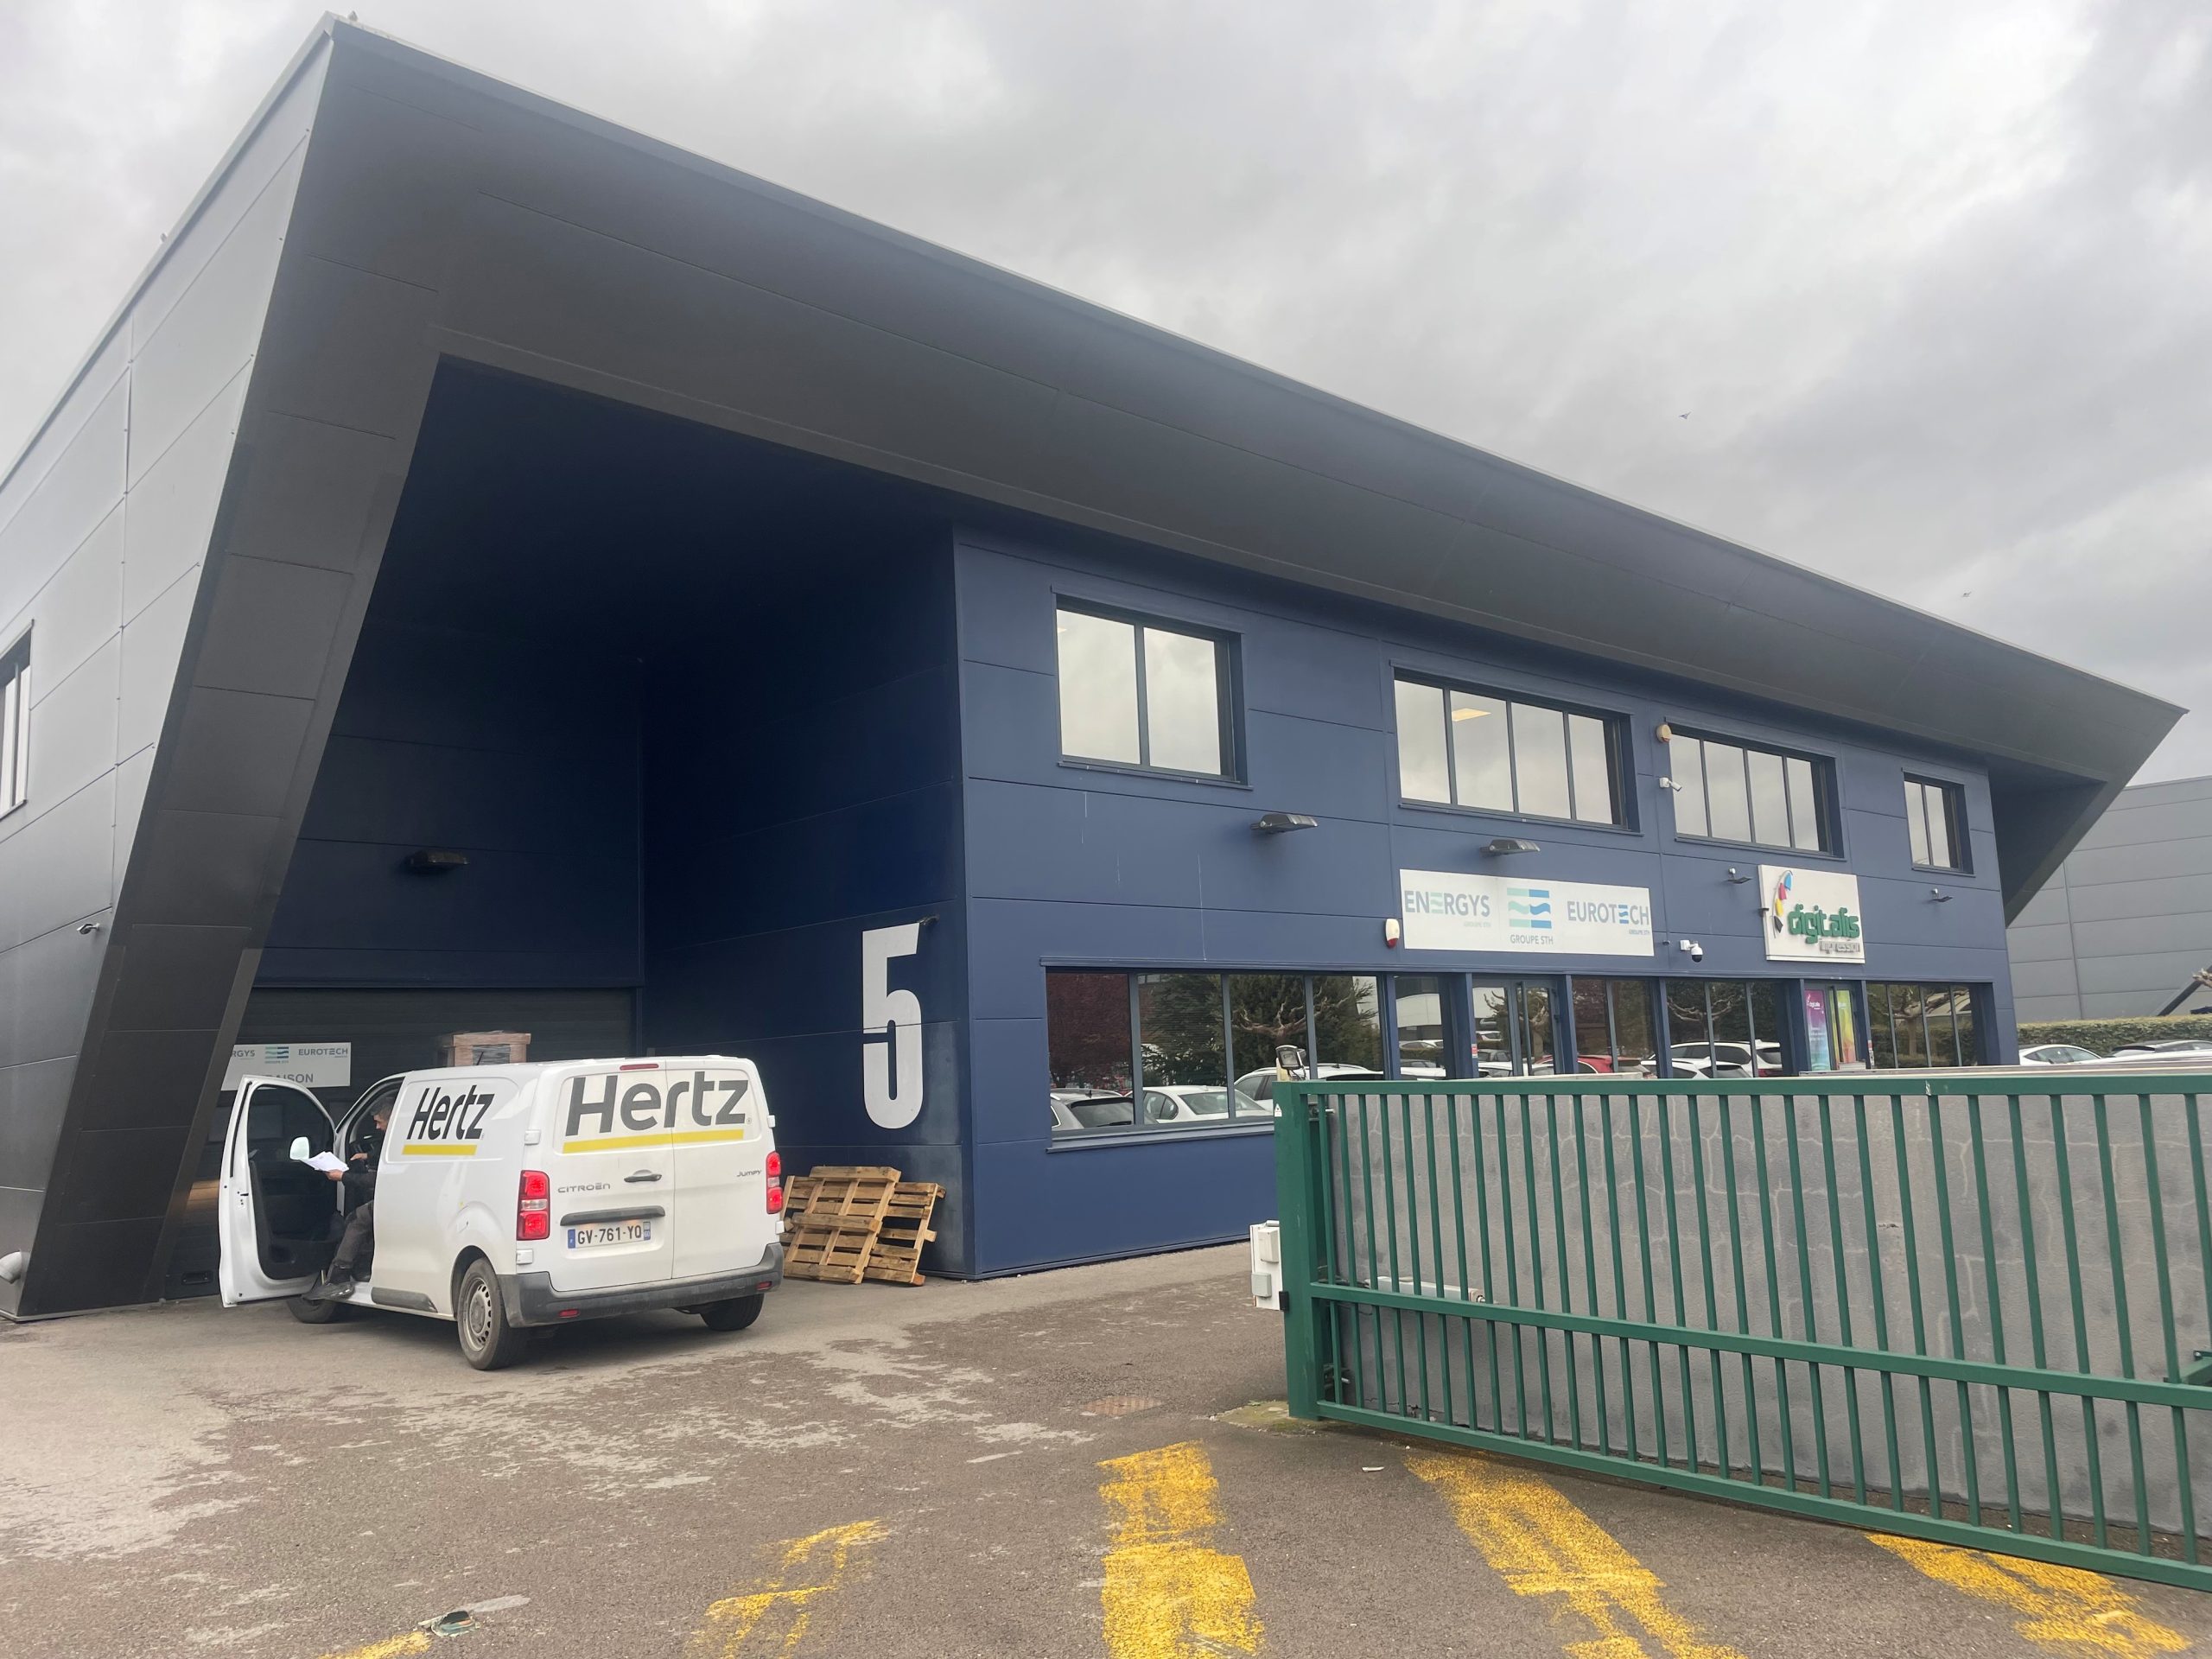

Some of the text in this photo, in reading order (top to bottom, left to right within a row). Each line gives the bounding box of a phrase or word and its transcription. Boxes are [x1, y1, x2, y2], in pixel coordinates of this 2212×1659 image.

[1404, 890, 1491, 918] ENERGYS
[1567, 900, 1649, 925] EUROTECH
[1510, 934, 1554, 945] GROUPE STH
[862, 922, 923, 1129] 5
[298, 1047, 348, 1056] EUROTECH
[406, 1084, 496, 1141] Hertz
[565, 1071, 748, 1137] Hertz
